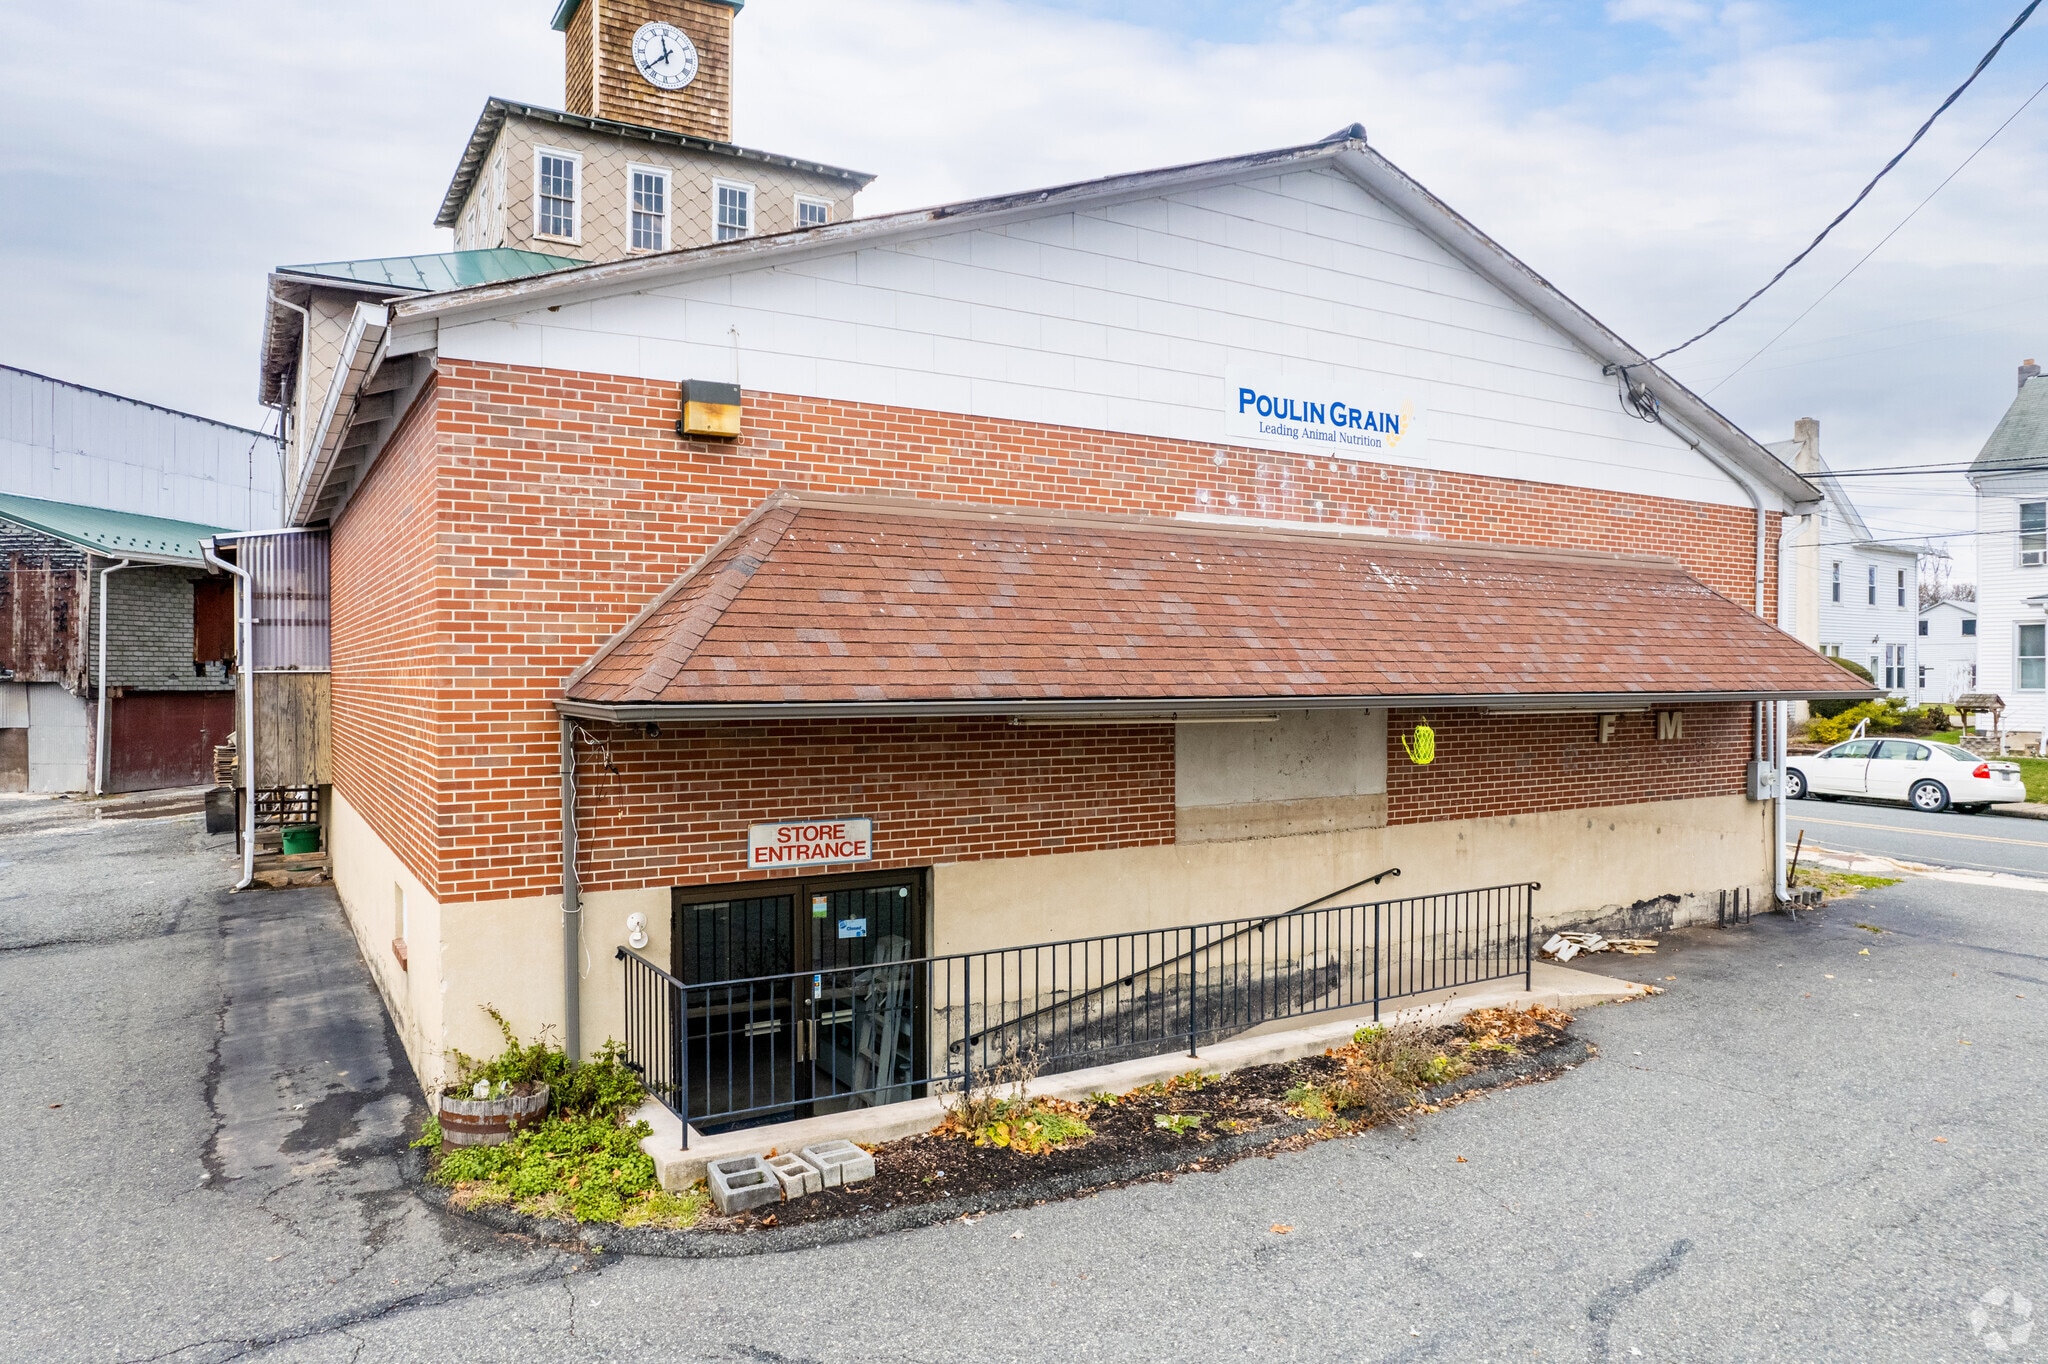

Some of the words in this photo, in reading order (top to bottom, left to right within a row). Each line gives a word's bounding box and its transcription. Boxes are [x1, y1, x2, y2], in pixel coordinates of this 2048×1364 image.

[1259, 421, 1299, 440] Leading
[1302, 427, 1337, 442] Animal
[1339, 431, 1382, 448] Nutrition
[1599, 713, 1616, 743] F
[1658, 711, 1682, 740] M
[777, 824, 845, 843] STORE
[755, 840, 866, 863] ENTRANCE
